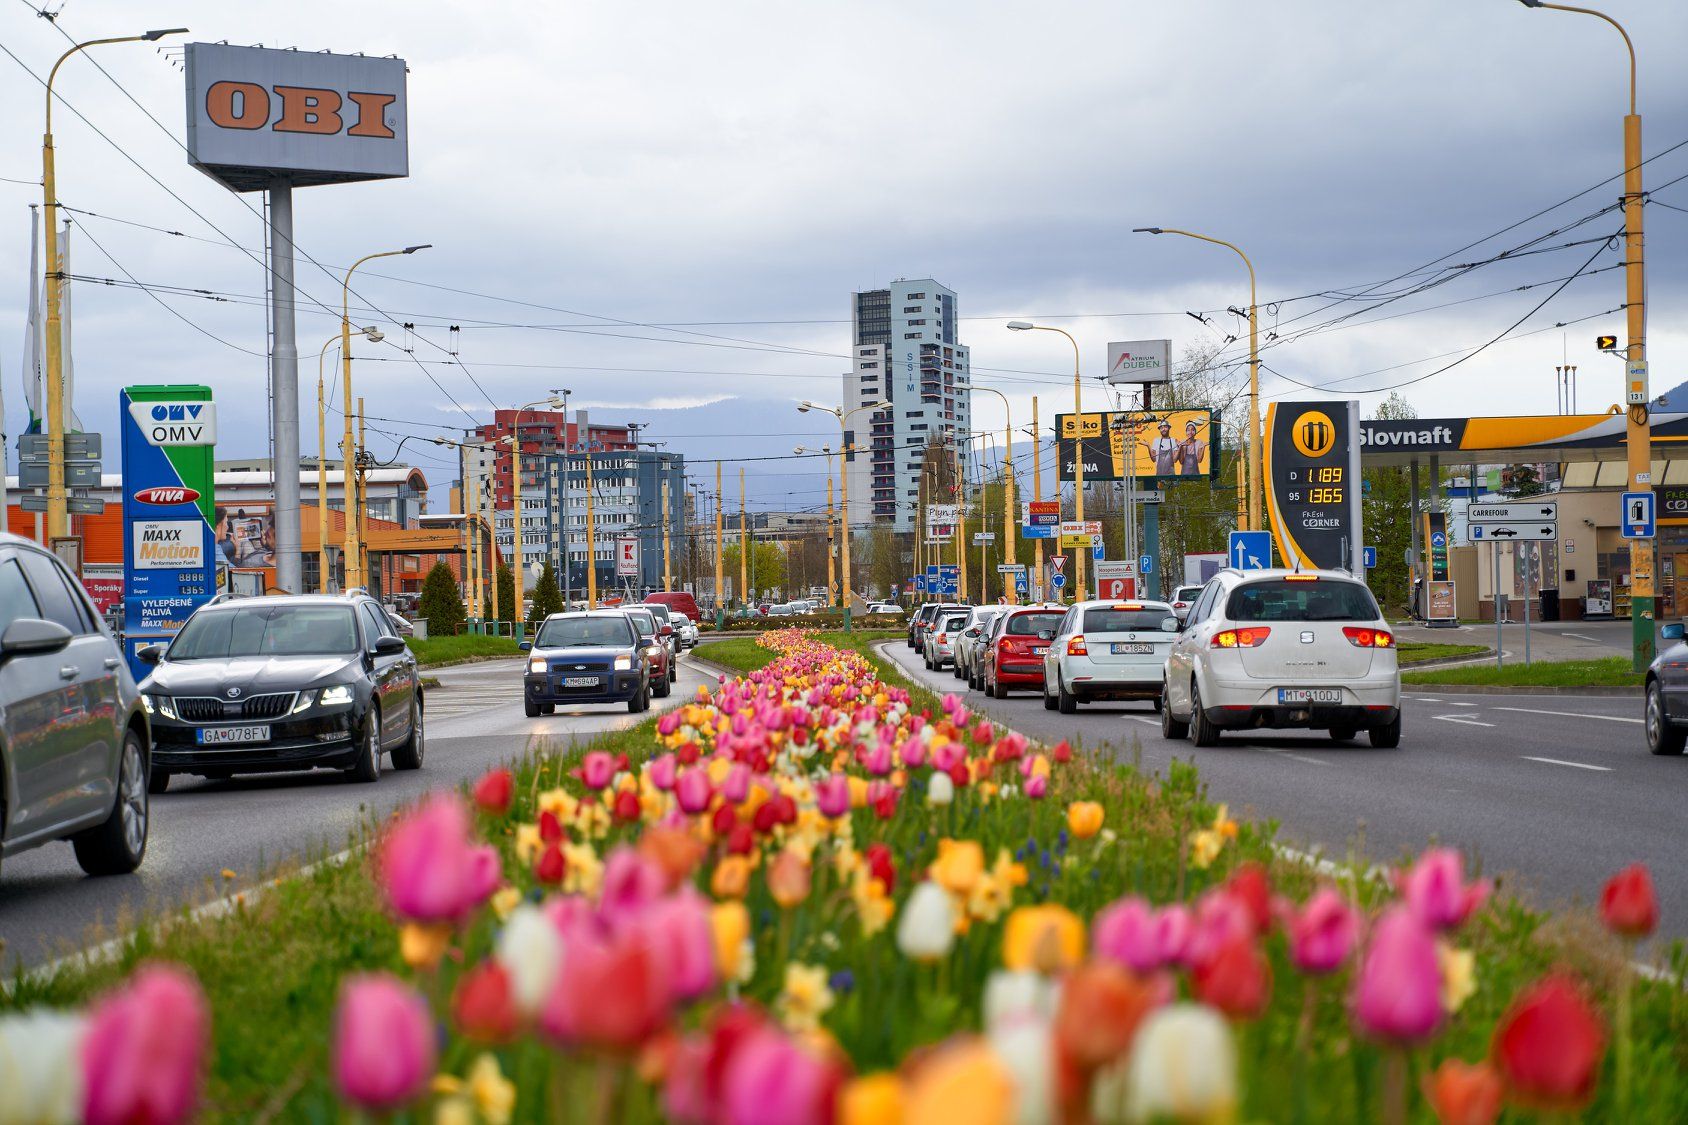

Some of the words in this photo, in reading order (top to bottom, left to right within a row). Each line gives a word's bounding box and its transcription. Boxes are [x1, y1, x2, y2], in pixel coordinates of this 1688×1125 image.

[206, 80, 397, 139] OBI
[151, 404, 203, 422] OMV
[152, 426, 202, 442] OMV
[1066, 461, 1099, 473] ŽINA
[1290, 471, 1298, 480] D
[150, 489, 185, 502] VIVA
[1288, 492, 1300, 501] 95
[1472, 509, 1509, 517] CARREFOUR
[1302, 518, 1340, 528] CORNER
[143, 530, 182, 541] MAXX
[140, 542, 200, 560] Motion
[141, 597, 193, 608] VYLEPŠENÉ
[142, 607, 172, 617] PALIVÁ
[141, 620, 162, 628] MAXX
